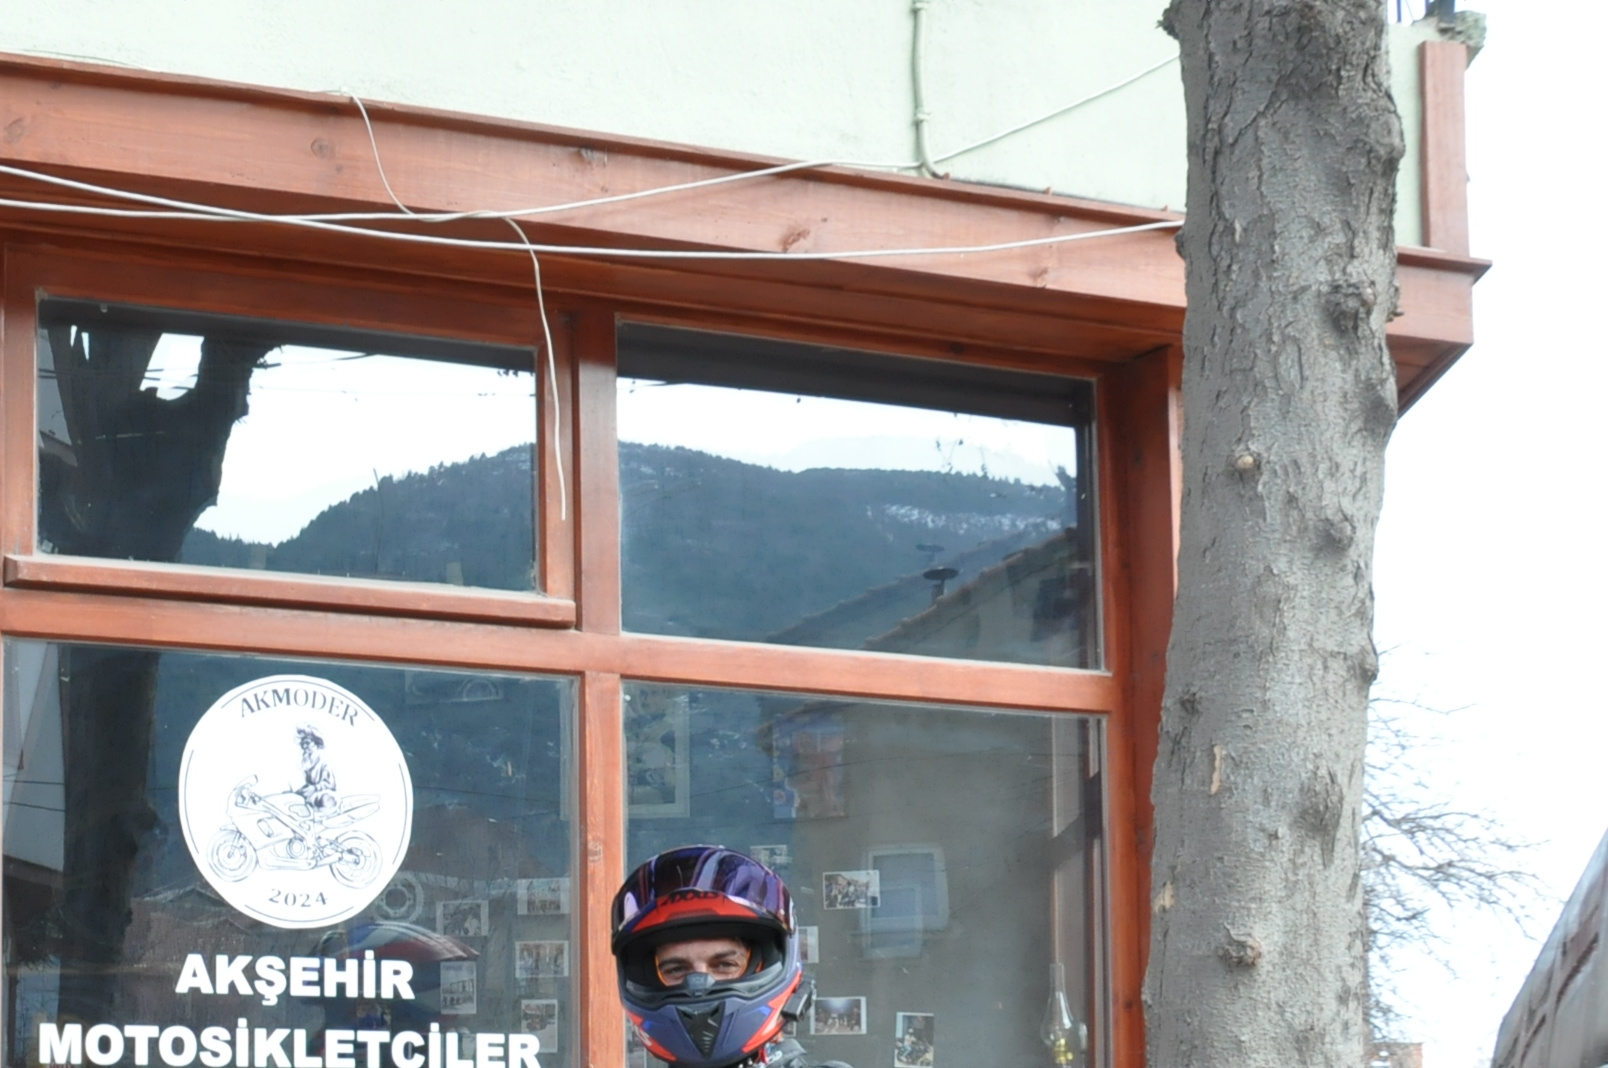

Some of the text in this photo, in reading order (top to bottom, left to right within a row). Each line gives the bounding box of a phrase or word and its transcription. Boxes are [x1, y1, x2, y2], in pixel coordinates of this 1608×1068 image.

[241, 688, 359, 726] AKMODER
[268, 888, 328, 908] 2024
[175, 949, 415, 1006] AKŞEHİR
